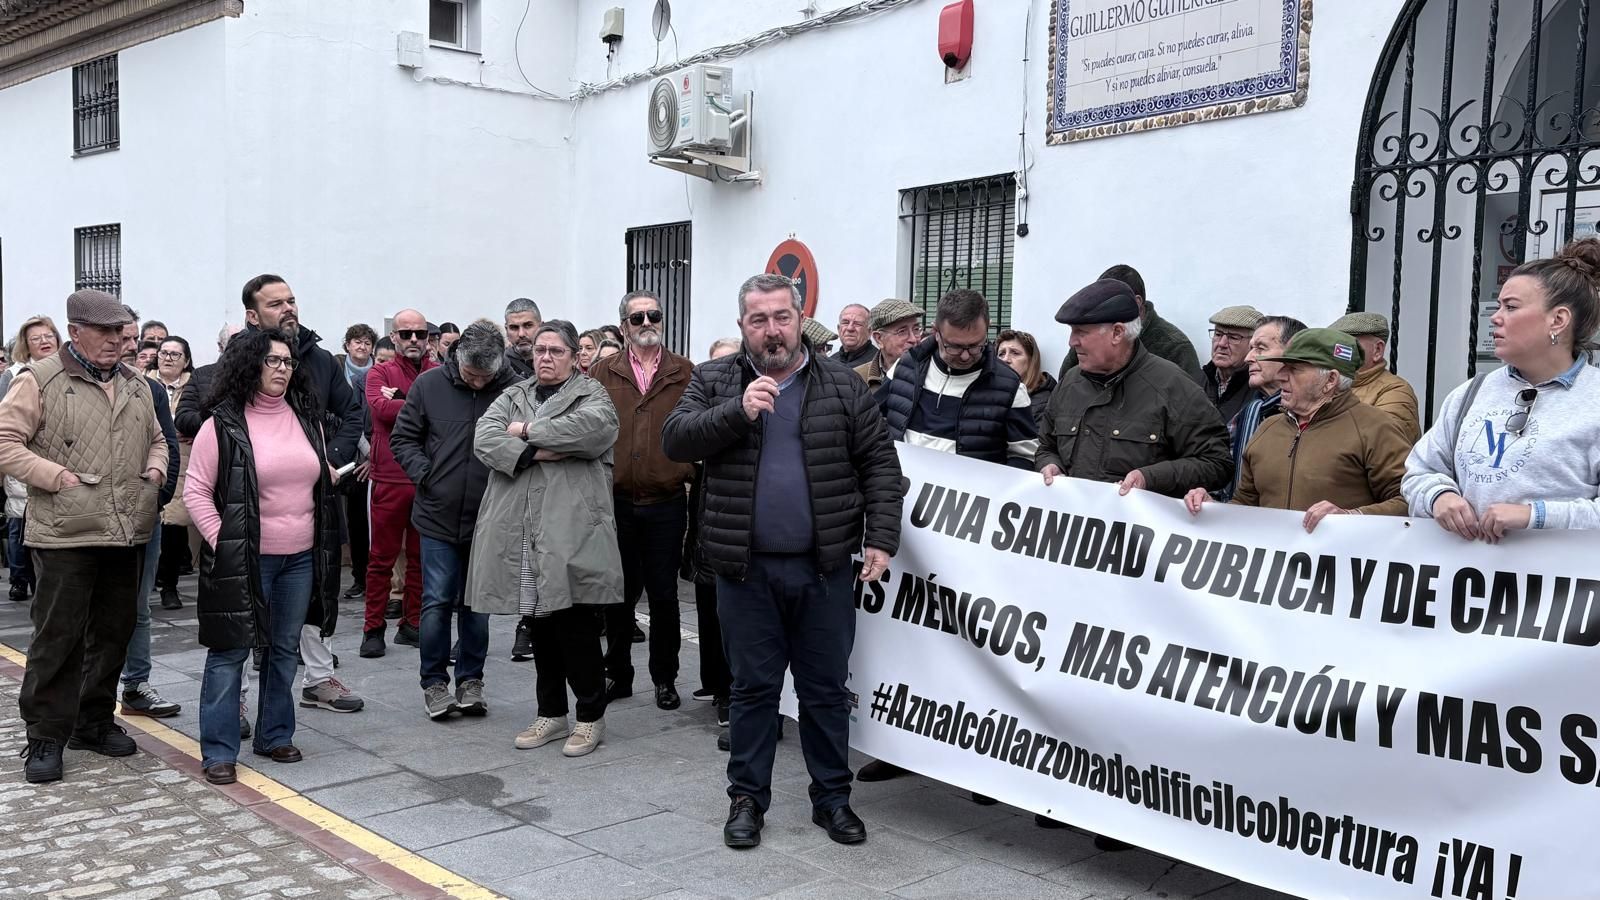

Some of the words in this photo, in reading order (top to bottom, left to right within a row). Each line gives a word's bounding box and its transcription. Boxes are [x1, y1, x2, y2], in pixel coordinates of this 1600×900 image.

[1070, 0, 1146, 37] GUILLERMO
[1091, 51, 1115, 75] puedes
[1116, 52, 1137, 64] curar,
[1138, 48, 1156, 60] cura.
[1157, 41, 1165, 56] Si
[1166, 43, 1177, 54] no
[1177, 31, 1205, 56] puedes
[1206, 31, 1230, 44] curar,
[1105, 79, 1112, 93] Y
[1112, 77, 1118, 92] si
[1119, 80, 1129, 91] no
[1129, 68, 1156, 93] puedes
[1156, 64, 1181, 83] aliviar,
[910, 482, 990, 544] UNA
[991, 502, 1155, 578] SANIDAD
[1154, 533, 1336, 616] PUBLICA
[1349, 557, 1378, 619] Y
[1380, 561, 1441, 629] DE
[1450, 566, 1600, 647] CALID
[891, 572, 1047, 672] MÉDICOS,
[1059, 622, 1151, 690] MAS
[1146, 643, 1367, 742] ATENCIÓN
[1376, 684, 1407, 749] Y
[1416, 691, 1543, 774] MAS
[1559, 713, 1600, 788] S
[870, 682, 1419, 885] #Aznalcóllarzonadedificilcobertura
